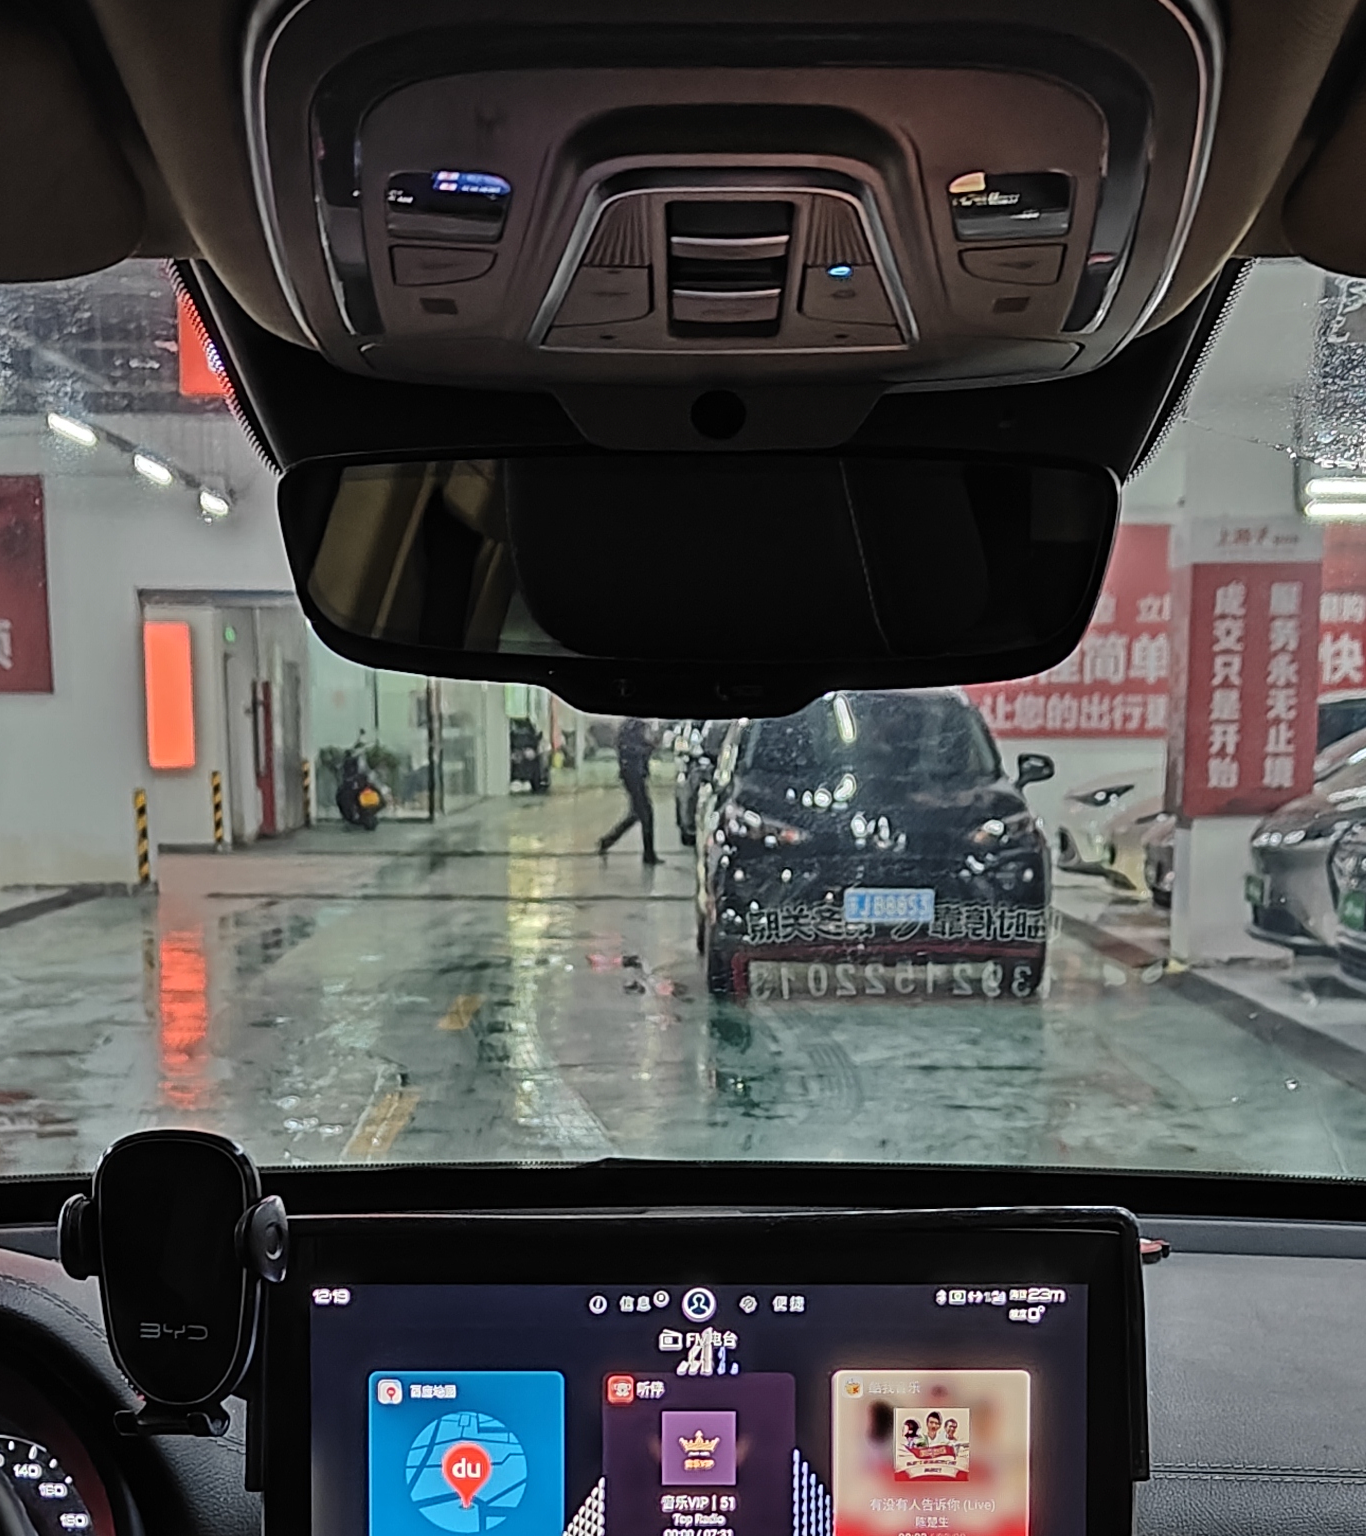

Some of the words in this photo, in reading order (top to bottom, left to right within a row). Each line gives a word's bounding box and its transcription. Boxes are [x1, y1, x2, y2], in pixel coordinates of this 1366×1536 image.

[1318, 632, 1366, 685] 快
[139, 1322, 209, 1341] BYD
[13, 1463, 43, 1479] 140
[451, 1458, 482, 1480] du
[870, 1498, 961, 1513] 有没有人告诉你
[963, 1498, 996, 1514] (Live)
[672, 1513, 694, 1528] Top
[695, 1513, 727, 1527] Radio
